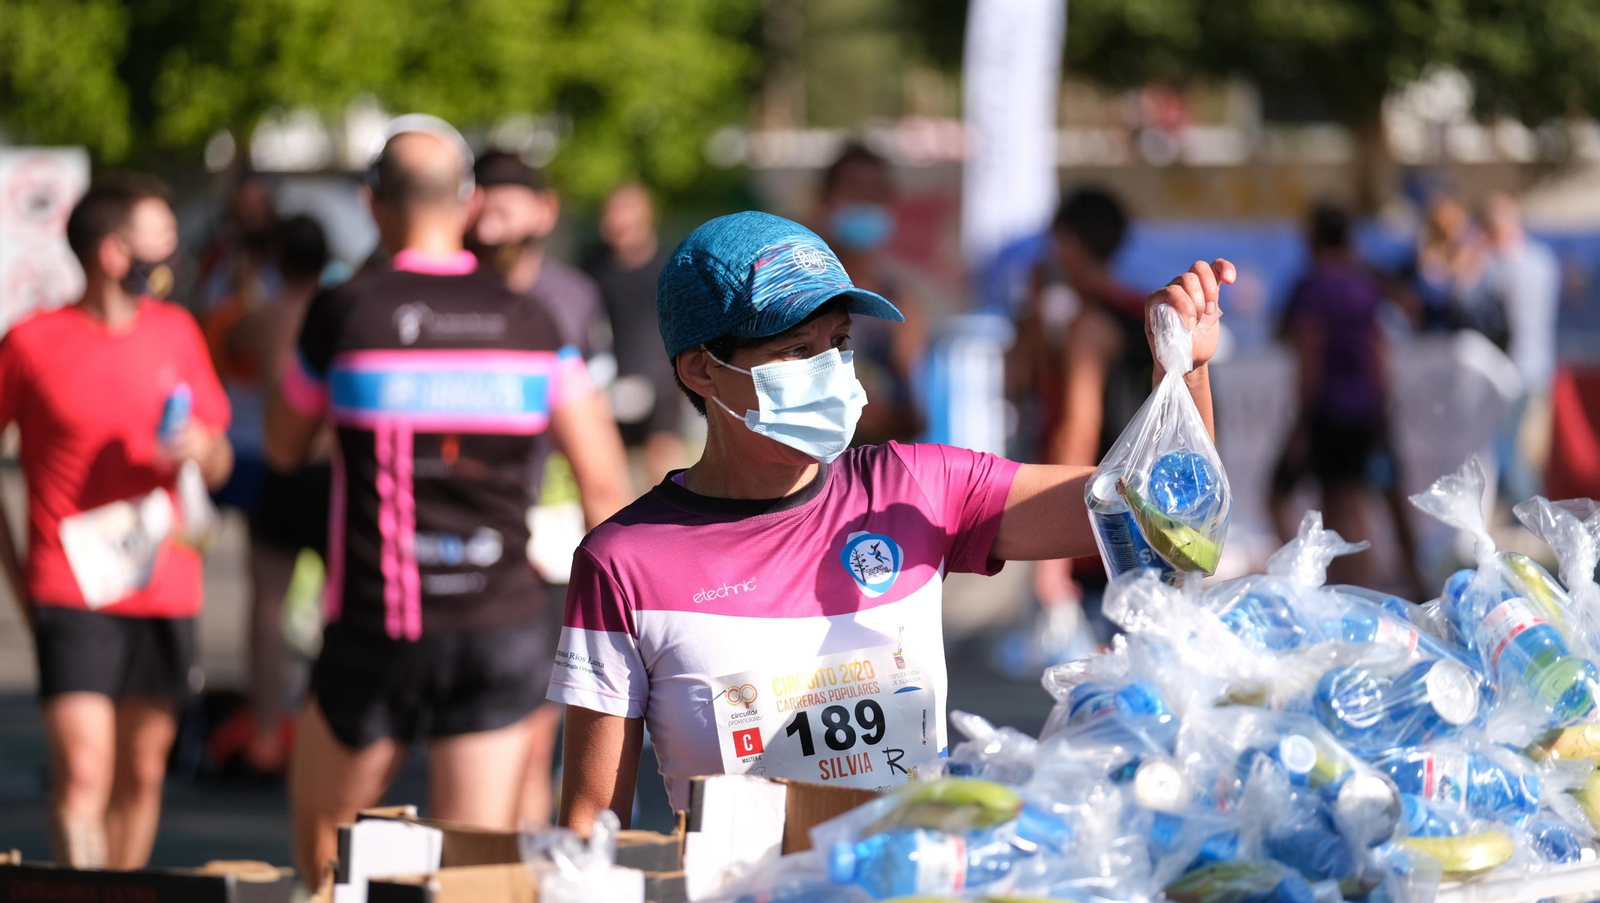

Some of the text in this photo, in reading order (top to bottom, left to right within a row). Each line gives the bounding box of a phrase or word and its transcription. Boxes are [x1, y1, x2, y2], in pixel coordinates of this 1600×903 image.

[693, 580, 757, 604] etechnic
[569, 651, 587, 662] Ríos
[588, 656, 605, 669] Luna
[771, 660, 876, 697] CIRCUITO 2020
[776, 681, 881, 713] CARRERAS POPULARES
[727, 714, 763, 728] provinciales
[730, 708, 758, 720] circuitos
[785, 698, 886, 757] 189
[742, 733, 754, 752] C
[818, 751, 874, 781] SILVIA
